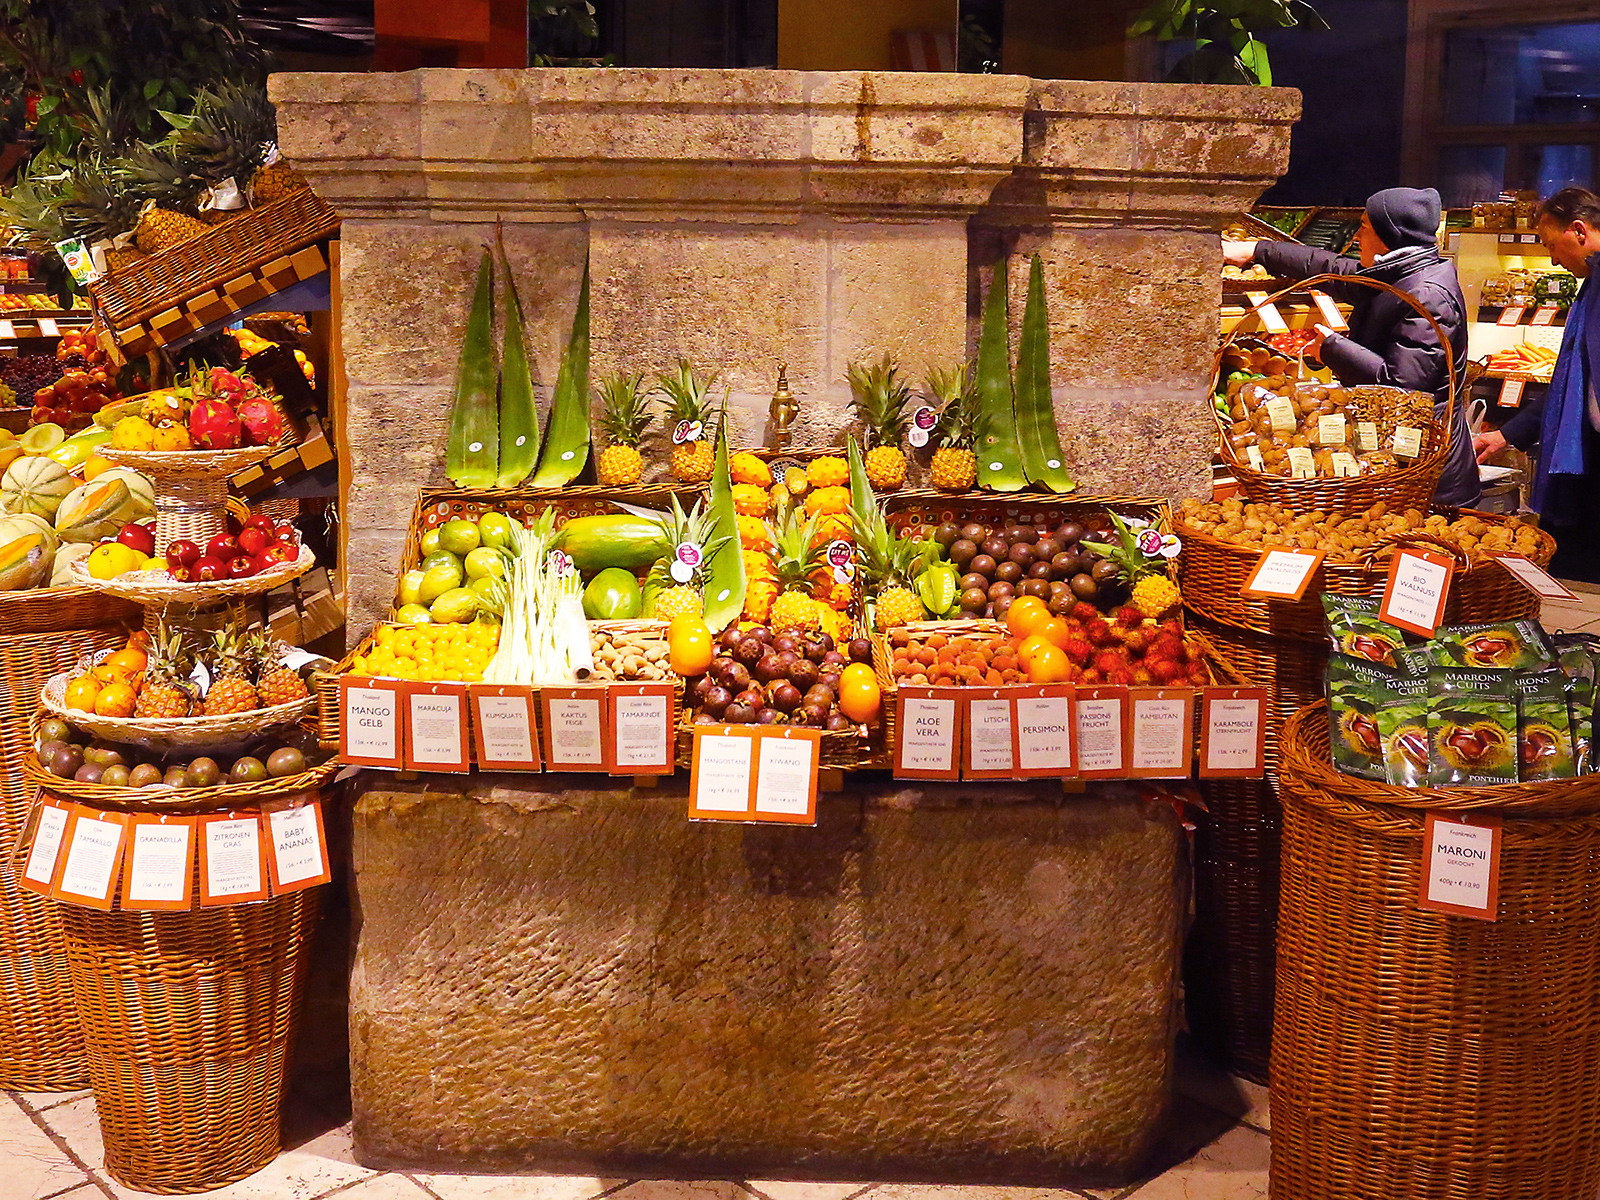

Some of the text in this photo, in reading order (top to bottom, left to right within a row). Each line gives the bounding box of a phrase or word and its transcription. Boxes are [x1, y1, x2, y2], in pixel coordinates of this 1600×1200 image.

[1413, 575, 1426, 584] BIO
[1400, 580, 1435, 597] WALNUSS
[1332, 595, 1378, 606] MARRONS
[1343, 602, 1372, 610] CUITS
[1355, 672, 1377, 684] CUI
[1445, 672, 1502, 682] MARRONS
[1514, 676, 1550, 686] RRONS
[1386, 678, 1429, 690] MARRO
[1456, 680, 1490, 690] CUITS
[351, 706, 390, 717] MANGO
[417, 705, 452, 713] MARACUJA
[359, 718, 383, 728] GELB
[916, 717, 940, 726] ALOE
[916, 728, 940, 737] VERA
[1023, 725, 1065, 734] PERSIMON
[1468, 774, 1516, 784] PONTHIER
[213, 832, 251, 841] ZITRONEN
[284, 827, 305, 838] BABY
[80, 834, 112, 848] TAMARILLO
[279, 836, 314, 851] ANANAS
[1437, 844, 1486, 860] MARONI
[1447, 859, 1475, 867] GEKOCHT
